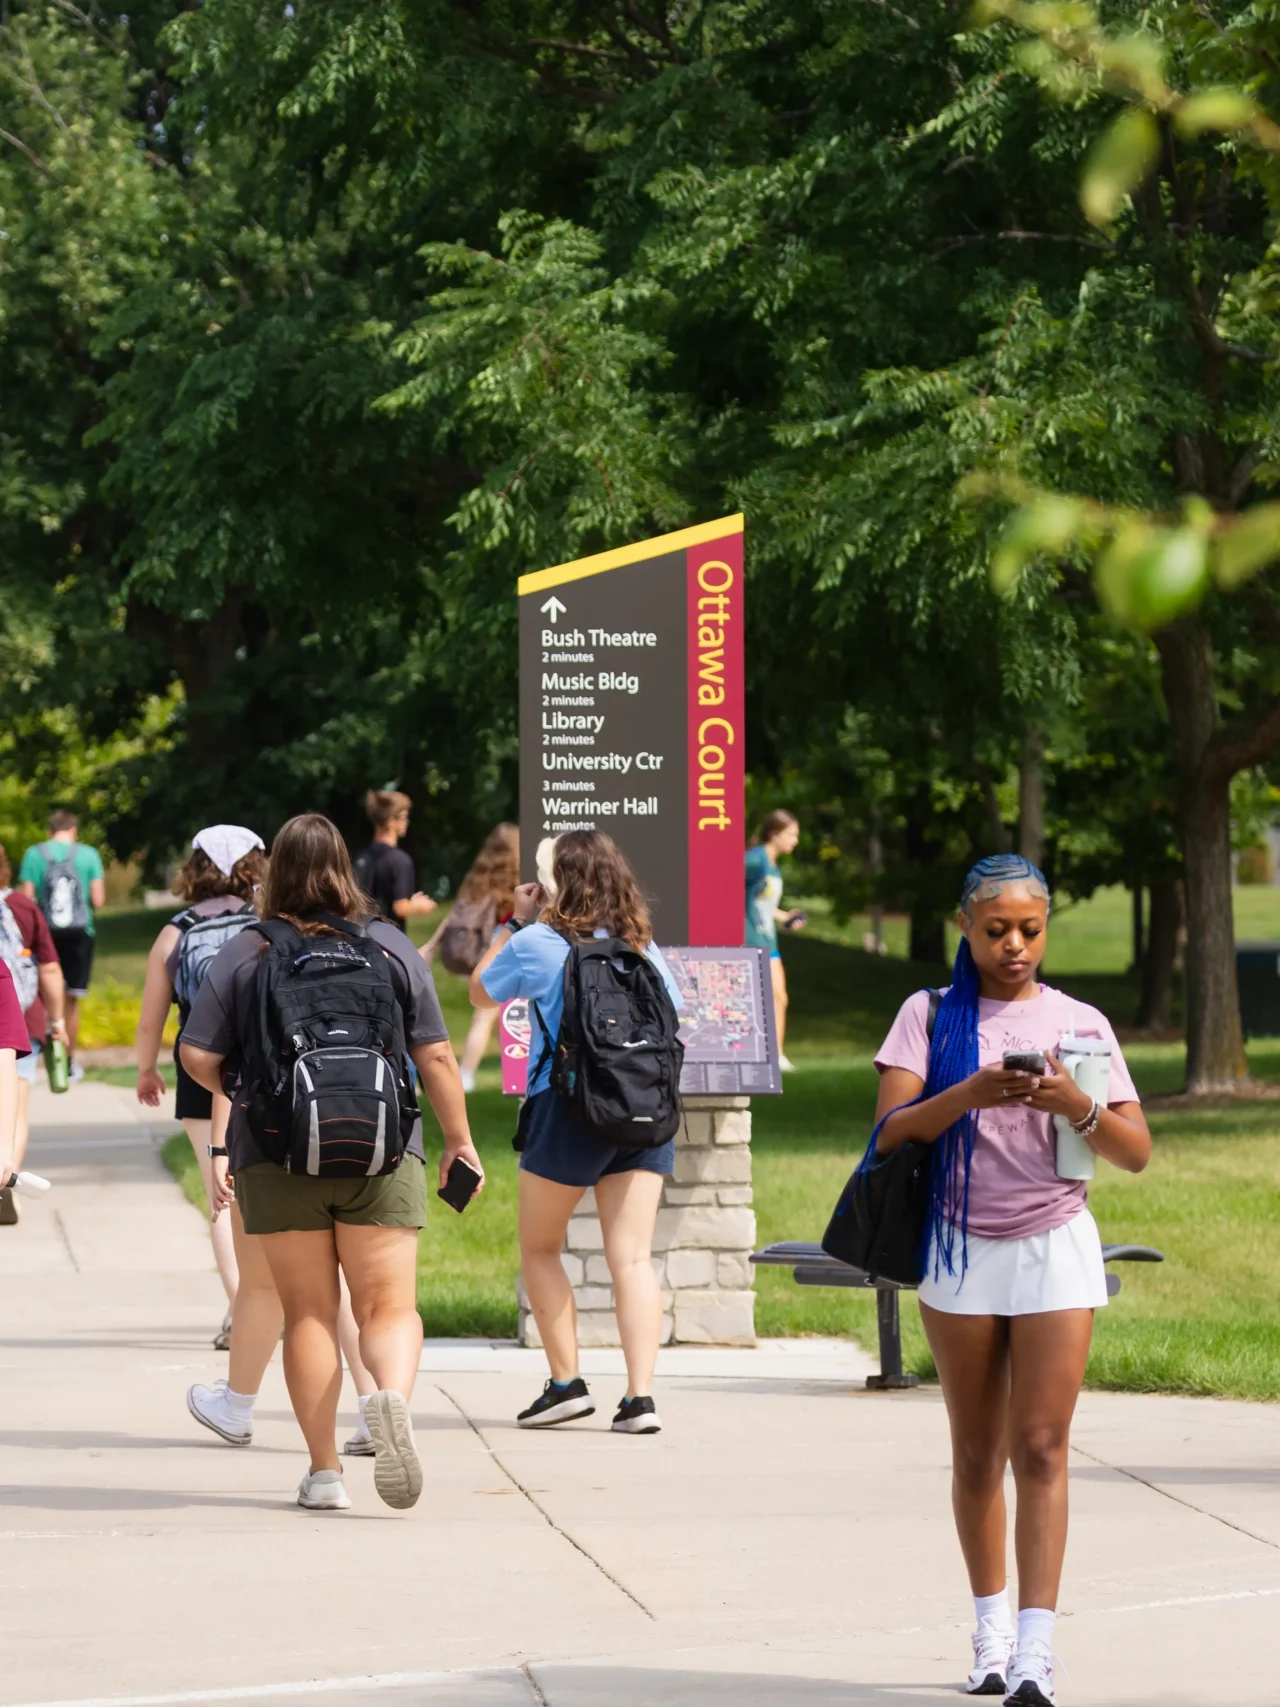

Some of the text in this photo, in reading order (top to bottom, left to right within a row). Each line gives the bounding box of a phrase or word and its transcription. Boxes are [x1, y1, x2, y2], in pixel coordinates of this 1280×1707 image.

[541, 628, 657, 647] Bush Theatre
[542, 651, 595, 663] 2 minutes
[541, 671, 639, 694] Music Bldg
[542, 695, 595, 706] 2 minutes
[697, 560, 735, 831] Ottawa Court
[542, 711, 605, 733] Library
[542, 734, 595, 745] 2 minutes
[542, 752, 664, 774] University Ctr
[542, 780, 595, 791] 3 minutes
[541, 796, 658, 815] Warriner Hall
[542, 820, 596, 831] 4 minutes
